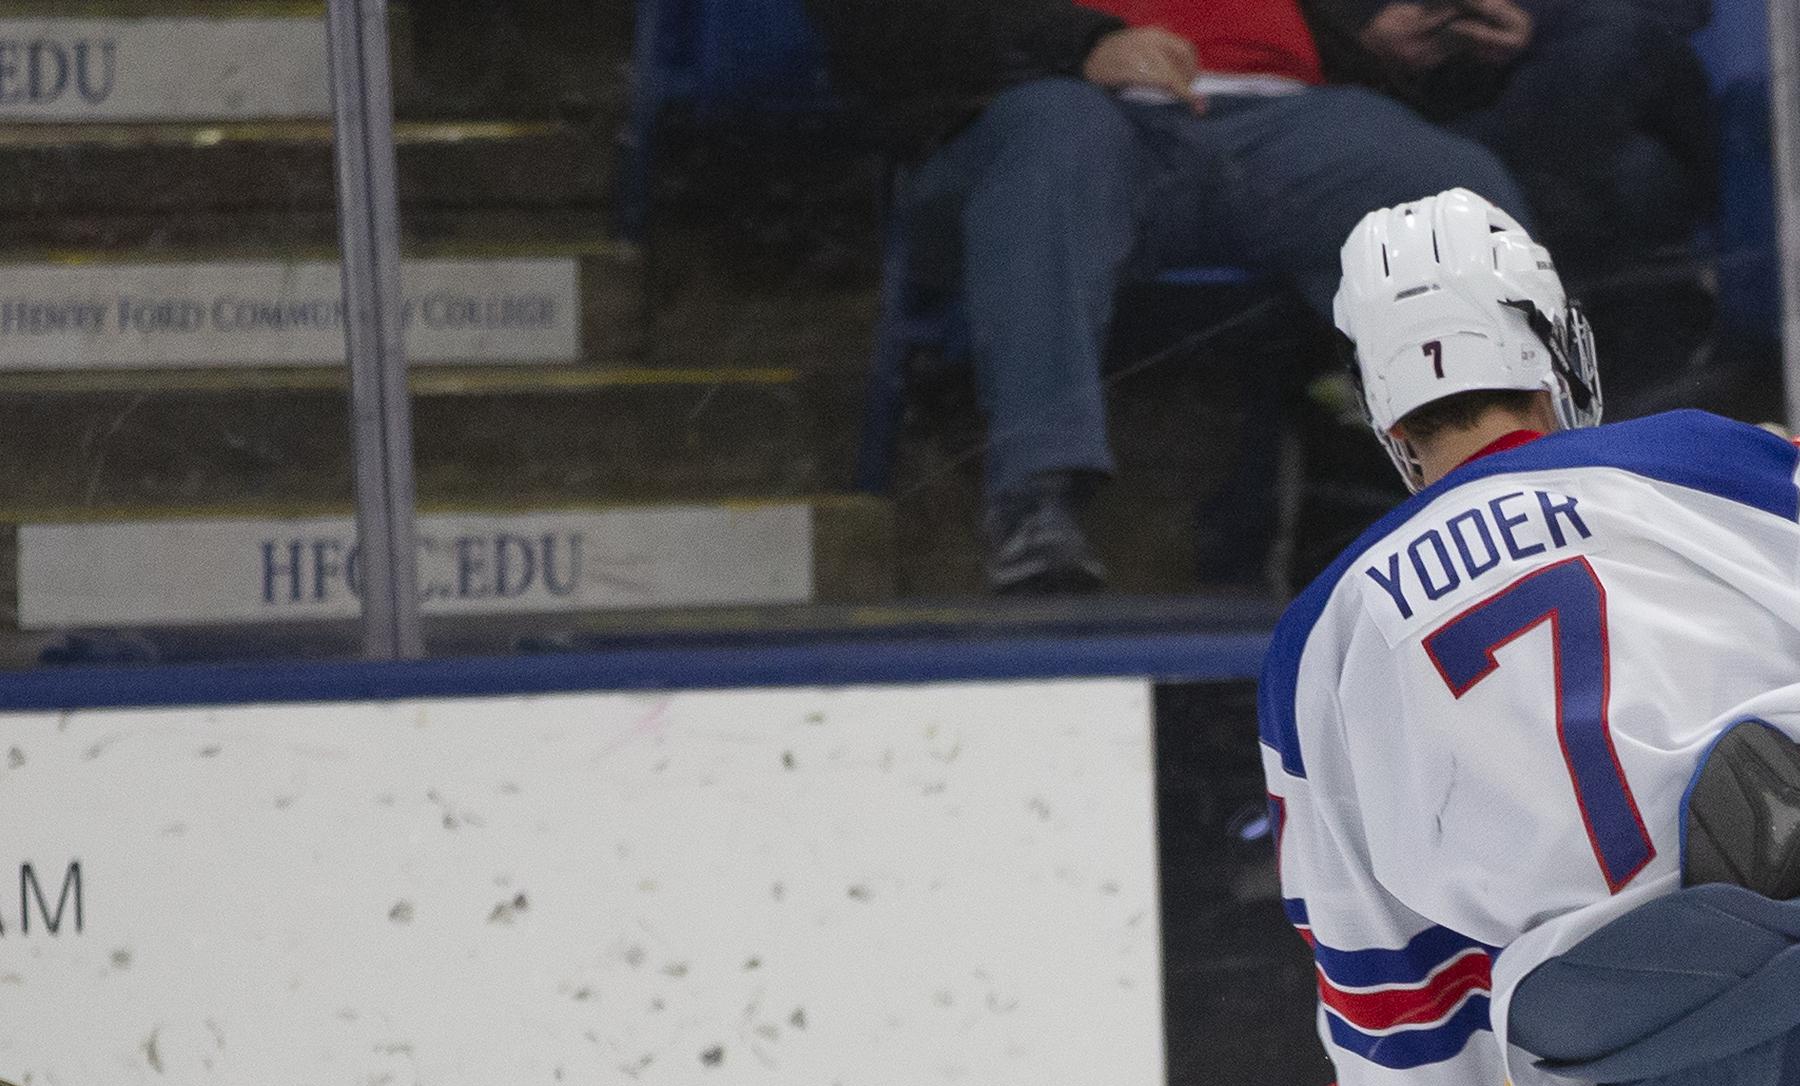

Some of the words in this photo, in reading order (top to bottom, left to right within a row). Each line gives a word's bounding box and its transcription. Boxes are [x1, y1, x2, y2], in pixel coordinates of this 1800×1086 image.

[118, 296, 204, 334] FORD
[1422, 340, 1445, 379] 7
[1366, 491, 1593, 621] YODER
[1421, 555, 1657, 896] 7
